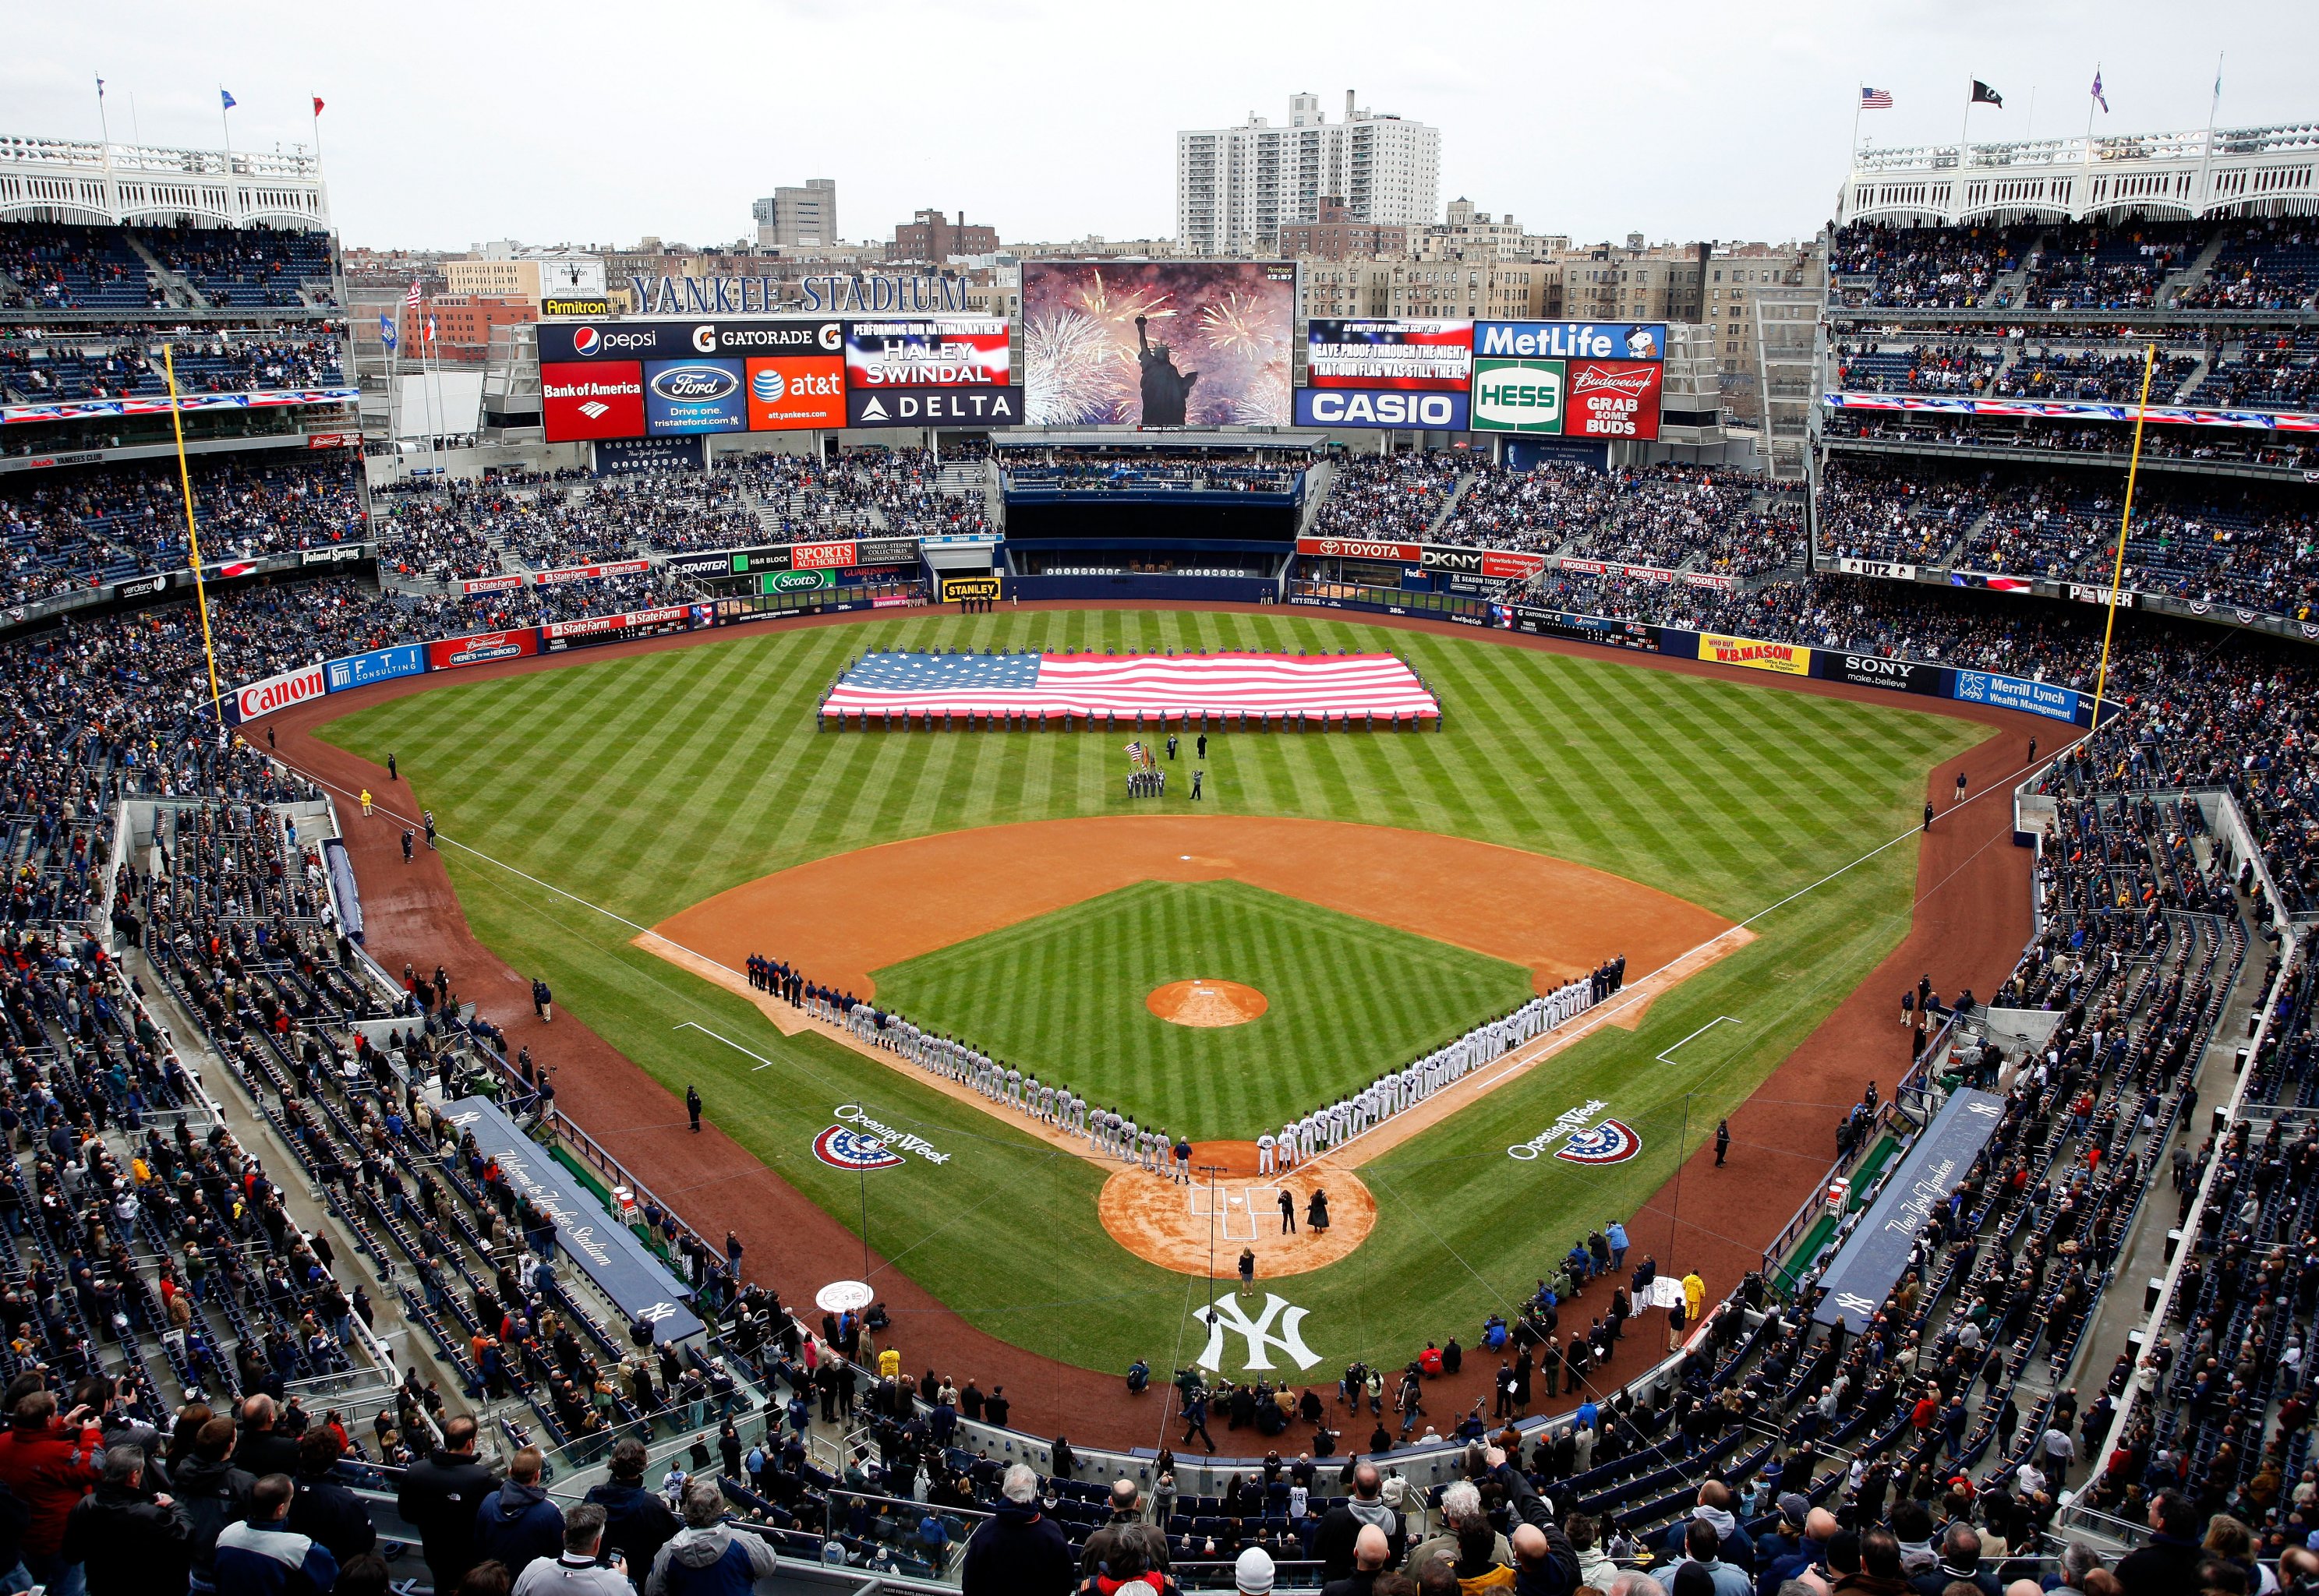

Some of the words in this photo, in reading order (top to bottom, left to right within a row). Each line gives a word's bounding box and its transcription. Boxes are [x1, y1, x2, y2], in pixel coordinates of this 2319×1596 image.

[628, 276, 780, 313] YANKEE
[802, 276, 969, 312] STADIUM
[547, 300, 606, 314] Armitron
[854, 323, 907, 336] PERFORMING
[908, 323, 924, 335] OUR
[926, 323, 967, 335] NATIONAL
[967, 323, 1002, 335] ANTHEM
[1352, 324, 1377, 333] WRITTEN
[1385, 324, 1409, 333] FRANCIS
[604, 330, 656, 350] pepsi
[722, 330, 812, 345] GATORADE
[1484, 324, 1612, 356] MetLife
[883, 340, 973, 361] HALEY
[1316, 343, 1340, 358] GAVE
[1341, 344, 1371, 358] PROOF
[1372, 344, 1416, 358] THROUGH
[1418, 345, 1435, 359] THE
[1436, 345, 1465, 360] NIGHT
[866, 363, 991, 384] SWINDAL
[1313, 362, 1338, 376] THAT
[1338, 362, 1359, 376] OUR
[1359, 363, 1382, 377] FLAG
[1384, 363, 1406, 377] WAS
[1406, 364, 1433, 378] STILL
[1434, 365, 1466, 380] THERE;
[1575, 369, 1651, 388] Budweiser
[544, 383, 576, 398] Bank
[577, 382, 589, 396] of
[591, 382, 641, 395] America
[672, 374, 719, 395] Ford
[790, 373, 840, 396] at&t
[1481, 384, 1555, 407] HESS
[670, 407, 698, 416] Drive
[900, 396, 1012, 418] DELTA
[1311, 393, 1453, 424] CASIO
[1586, 397, 1638, 411] GRAB
[655, 418, 728, 427] tristateford.com
[768, 410, 826, 420] att.yankees.com
[1595, 411, 1628, 421] SOME
[1586, 420, 1635, 435] BUDS
[31, 459, 55, 468] Audi
[57, 455, 85, 464] YANKEES
[302, 553, 331, 565] Poland
[331, 548, 359, 560] Spring
[796, 546, 851, 560] SPORTS
[1342, 542, 1400, 558] TOYOTA
[682, 560, 727, 573] STARTER
[1423, 552, 1482, 569] DKNY
[1563, 561, 1601, 572] MODELL'S
[844, 566, 900, 577] GUARDSMARK
[1405, 568, 1427, 578] FedEx
[1628, 569, 1669, 580] MODELL'S
[1862, 563, 1891, 577] UTZ
[122, 583, 152, 595] verdero
[780, 574, 815, 588] Scotts
[1688, 575, 1730, 588] MODELL'S
[949, 584, 995, 595] STANLEY
[465, 639, 505, 648] Budweiser
[454, 653, 476, 662] HERE'S
[490, 648, 516, 656] HEROES
[356, 662, 416, 681] CONSULTING
[1846, 656, 1914, 676] SONY
[1848, 673, 1907, 688] make.believe
[240, 670, 323, 716] Canon
[1991, 678, 2030, 697] Merrill
[2034, 687, 2064, 704] Lynch
[1989, 693, 2017, 707] Wealth
[2020, 700, 2070, 719] Management
[834, 1104, 904, 1144] Opening
[897, 1133, 951, 1165] Week
[1508, 1121, 1578, 1160] Opening
[1555, 1100, 1608, 1124] Week
[494, 1149, 535, 1188] Welcome
[1916, 1158, 1955, 1198] Yankees
[528, 1183, 546, 1197] to
[530, 1191, 578, 1228] Yankee
[1900, 1188, 1933, 1219] York
[1885, 1211, 1918, 1235] New
[567, 1225, 611, 1266] Stadium
